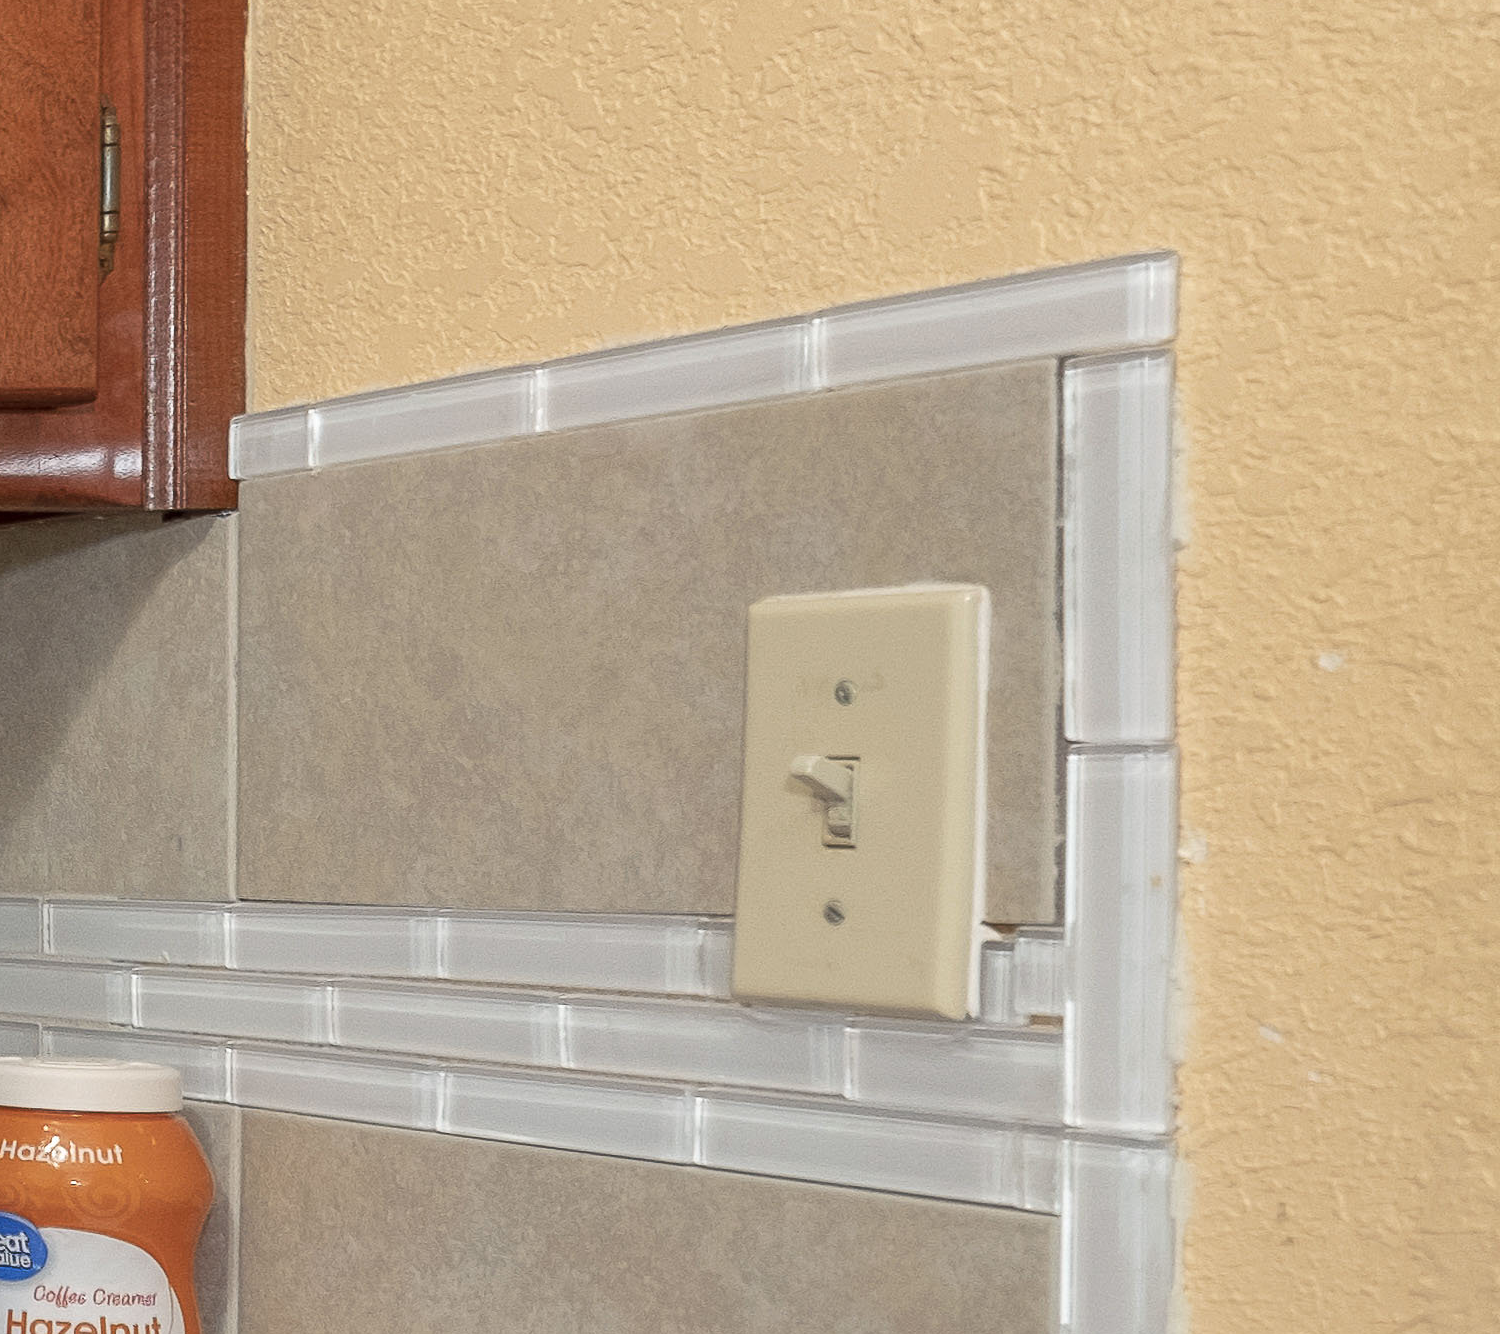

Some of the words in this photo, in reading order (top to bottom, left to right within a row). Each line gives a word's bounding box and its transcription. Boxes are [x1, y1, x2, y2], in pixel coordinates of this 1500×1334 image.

[0, 1139, 123, 1165] Hazelnut
[33, 1285, 87, 1307] Coffee
[92, 1288, 157, 1306] Creamer
